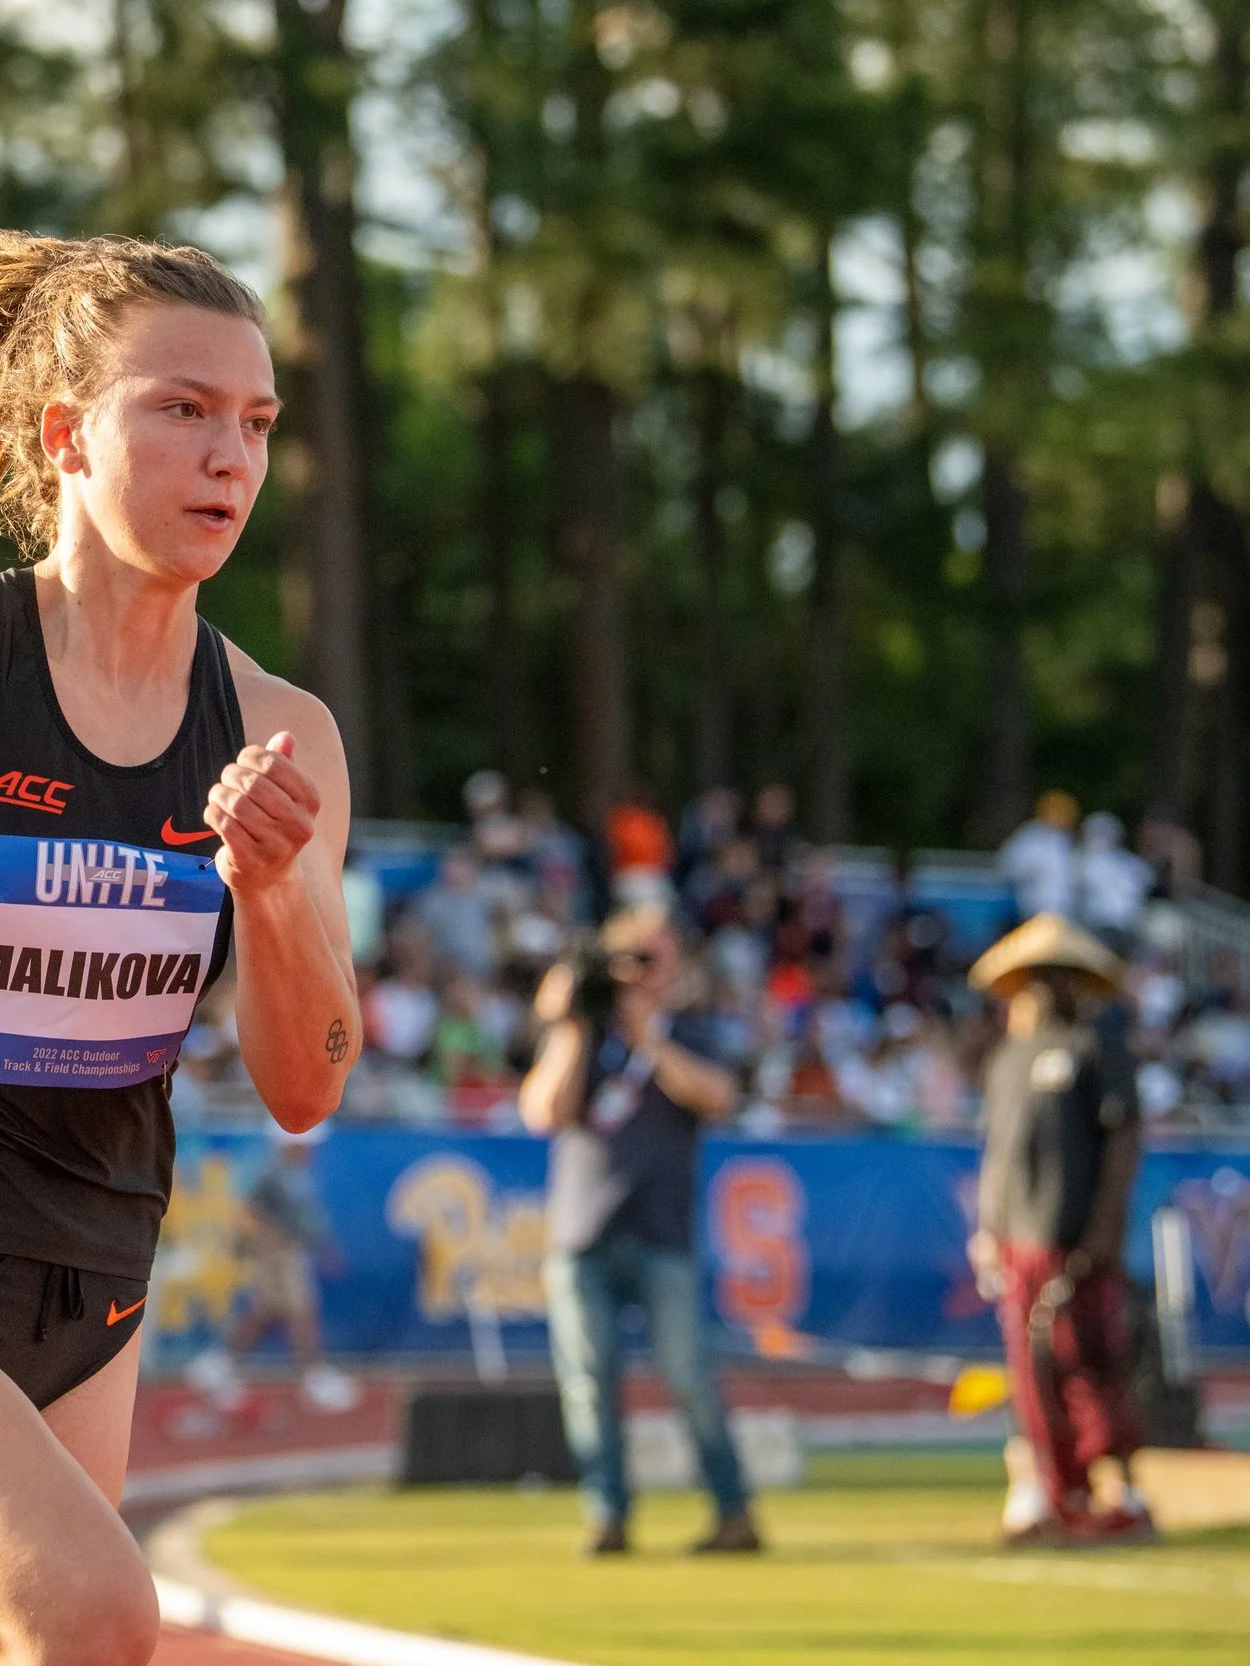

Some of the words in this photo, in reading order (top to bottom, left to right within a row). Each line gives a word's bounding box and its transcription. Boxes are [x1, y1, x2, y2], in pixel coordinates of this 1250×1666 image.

[35, 840, 168, 907] UNITE
[89, 869, 123, 882] ACC
[32, 1047, 57, 1060] 2022
[59, 1049, 80, 1061] ACC
[83, 1050, 120, 1062] Outdoor
[3, 1058, 31, 1072] Track
[34, 1061, 42, 1072] &
[44, 1062, 69, 1074] Field
[71, 1062, 141, 1077] Championships
